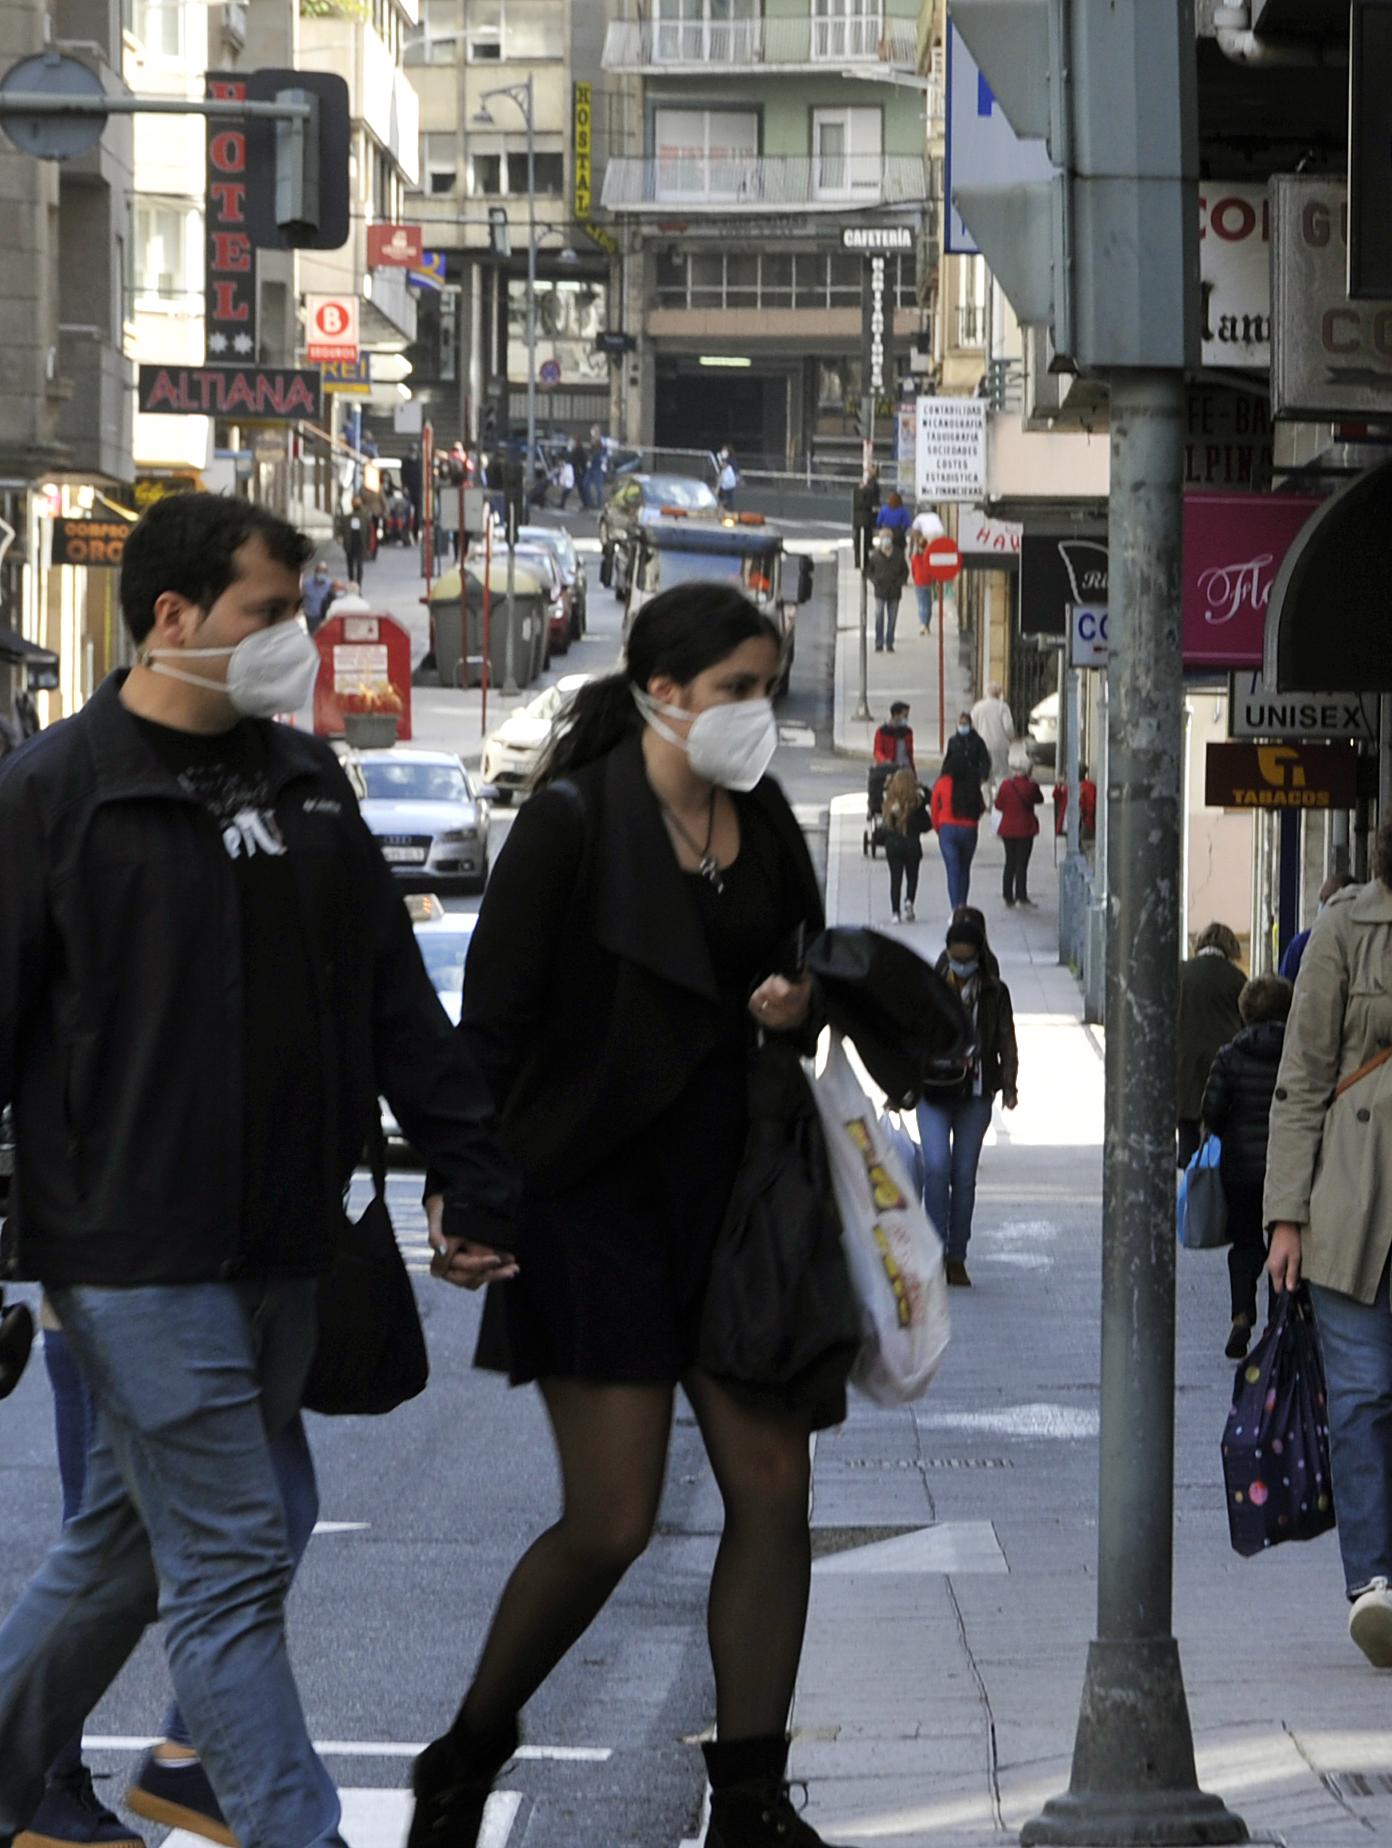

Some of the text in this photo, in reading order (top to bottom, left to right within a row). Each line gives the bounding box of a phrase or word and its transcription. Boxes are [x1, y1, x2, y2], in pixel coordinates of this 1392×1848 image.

[577, 87, 591, 213] HOSTAL
[210, 81, 251, 321] HOTEL
[145, 369, 314, 413] ALTIANA
[923, 405, 982, 415] CONTABILIDAD
[927, 446, 977, 455] SOCIEDADES
[936, 460, 968, 469] COSTES
[65, 521, 129, 538] COMPRO
[66, 538, 124, 561] ORO
[1245, 704, 1361, 730] UNISEX
[1232, 789, 1331, 806] TABACOS
